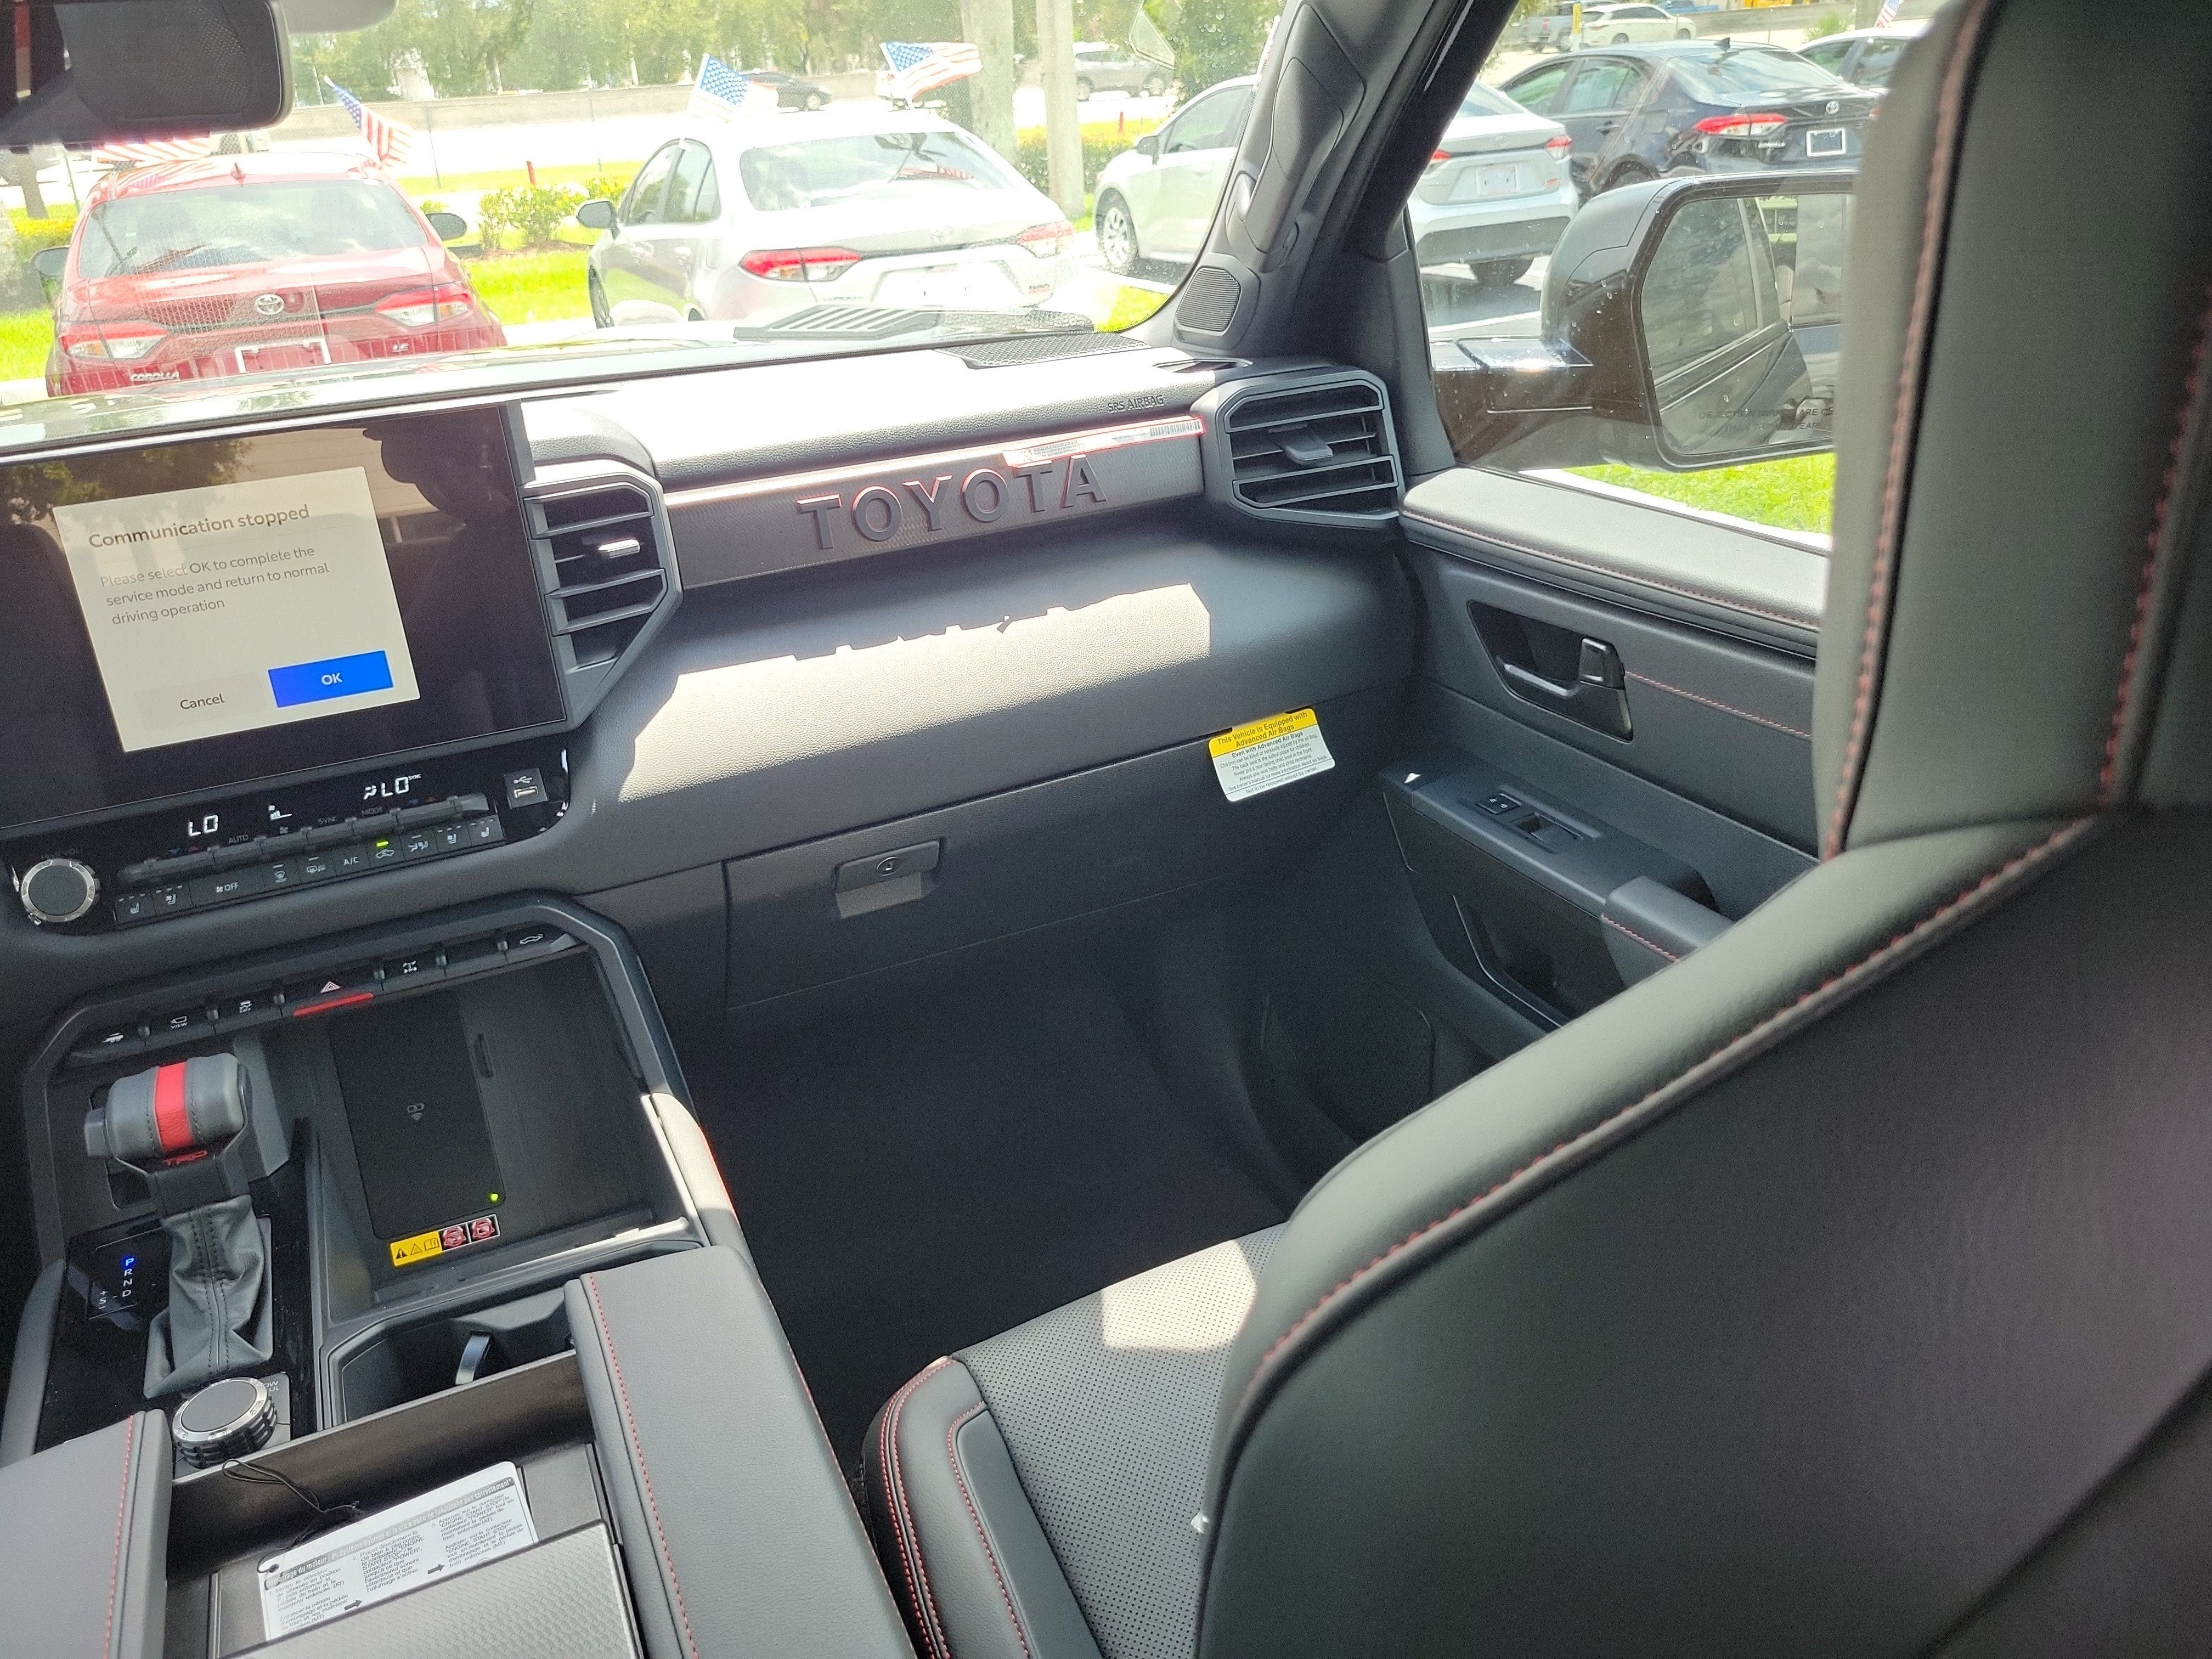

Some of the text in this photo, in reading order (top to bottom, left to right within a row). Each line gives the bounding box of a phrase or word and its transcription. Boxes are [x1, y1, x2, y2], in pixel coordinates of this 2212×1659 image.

[131, 371, 181, 381] COROLLA
[1108, 394, 1164, 414] SRS AIRBAG
[795, 455, 1107, 549] TOYOTA
[88, 504, 310, 548] Communication stopped
[100, 546, 315, 588] Please select OK to complete the
[106, 562, 329, 606] service mode and return to normal
[112, 599, 225, 625] driving operation
[321, 673, 343, 685] OK
[180, 693, 225, 709] Cancel
[1217, 736, 1232, 744] This
[1233, 729, 1255, 740] Vehicle
[1264, 716, 1293, 730] Equipped
[1294, 712, 1307, 720] with
[1236, 725, 1294, 747] Advanced Air Bags
[1257, 738, 1282, 750] Advanced
[362, 806, 383, 815] MODE
[188, 815, 218, 837] LO
[229, 834, 249, 843] AUTO
[343, 856, 359, 866] A/C
[225, 882, 239, 891] OFF
[163, 1150, 207, 1165] TRD
[125, 1257, 134, 1266] P
[124, 1268, 133, 1277] R
[123, 1278, 133, 1287] N
[466, 1506, 483, 1516] START
[439, 1512, 460, 1524] Appuyer
[441, 1519, 466, 1532] contacteur
[442, 1522, 470, 1537] maintenant
[403, 1534, 420, 1543] contre
[445, 1538, 466, 1550] Appuyer
[486, 1519, 512, 1532] contacteur
[473, 1532, 490, 1542] START
[360, 1547, 378, 1558] Placer
[379, 1533, 411, 1549] directement
[469, 1535, 495, 1549] maintenant
[369, 1548, 398, 1562] contacteur
[307, 1558, 326, 1569] moteur
[363, 1560, 382, 1570] START
[364, 1560, 392, 1575] contacteur
[400, 1558, 419, 1568] sonore
[366, 1574, 393, 1588] retentisse
